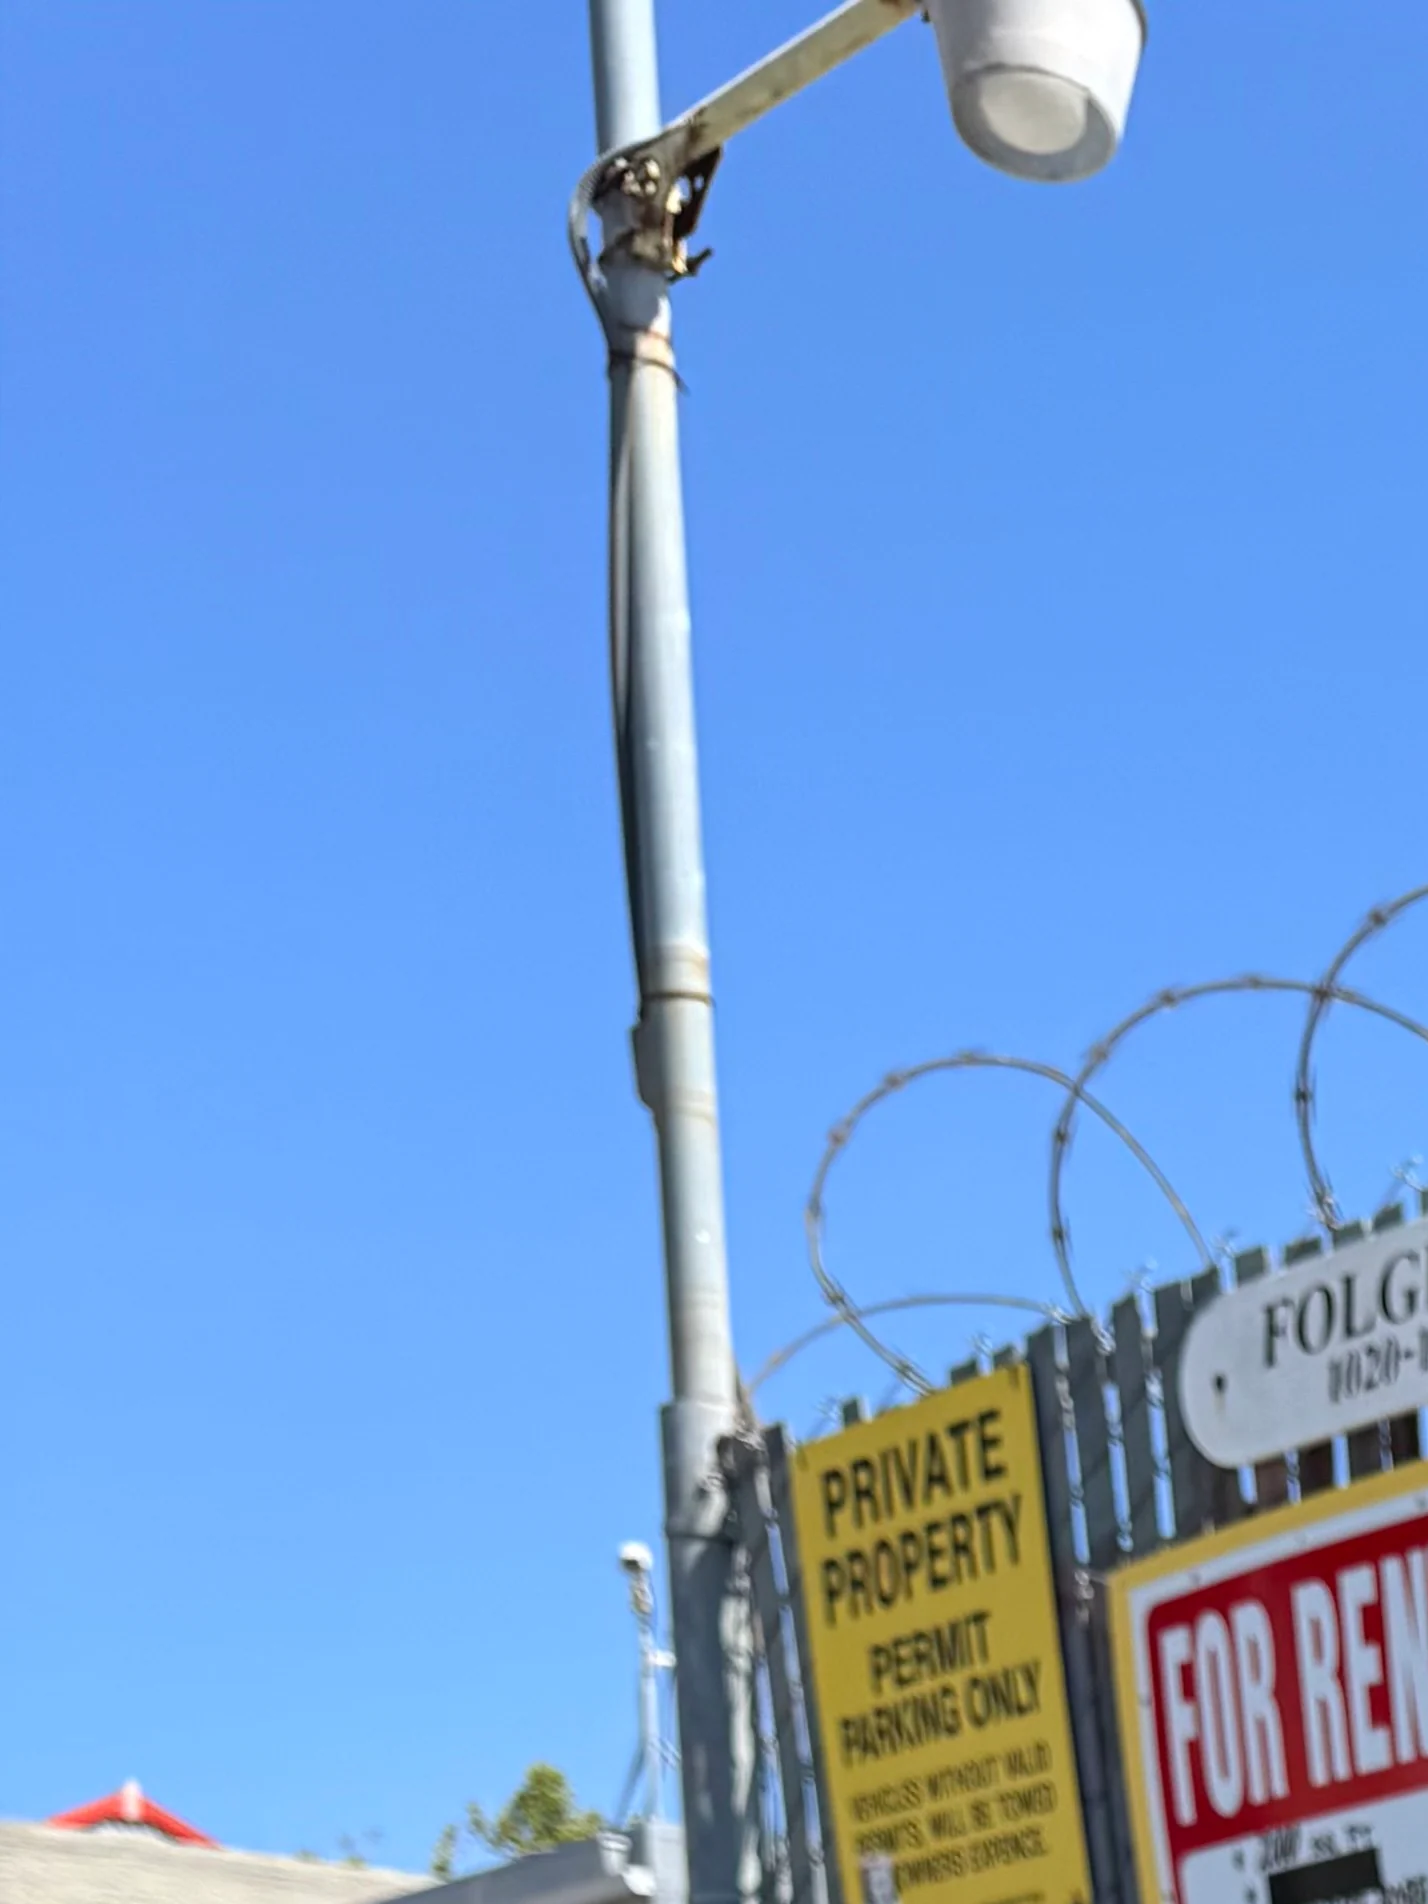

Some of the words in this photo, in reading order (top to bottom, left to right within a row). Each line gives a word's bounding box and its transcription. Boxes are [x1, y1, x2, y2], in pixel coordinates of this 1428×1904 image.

[820, 1406, 1007, 1541] PRIVATE
[820, 1492, 1022, 1630] PROPERTY
[867, 1609, 992, 1695] PERMIT
[1156, 1598, 1289, 1829] FOR
[838, 1685, 963, 1770] PARKING
[964, 1659, 1042, 1730] ONLY
[926, 1757, 1000, 1800] WITHOUT
